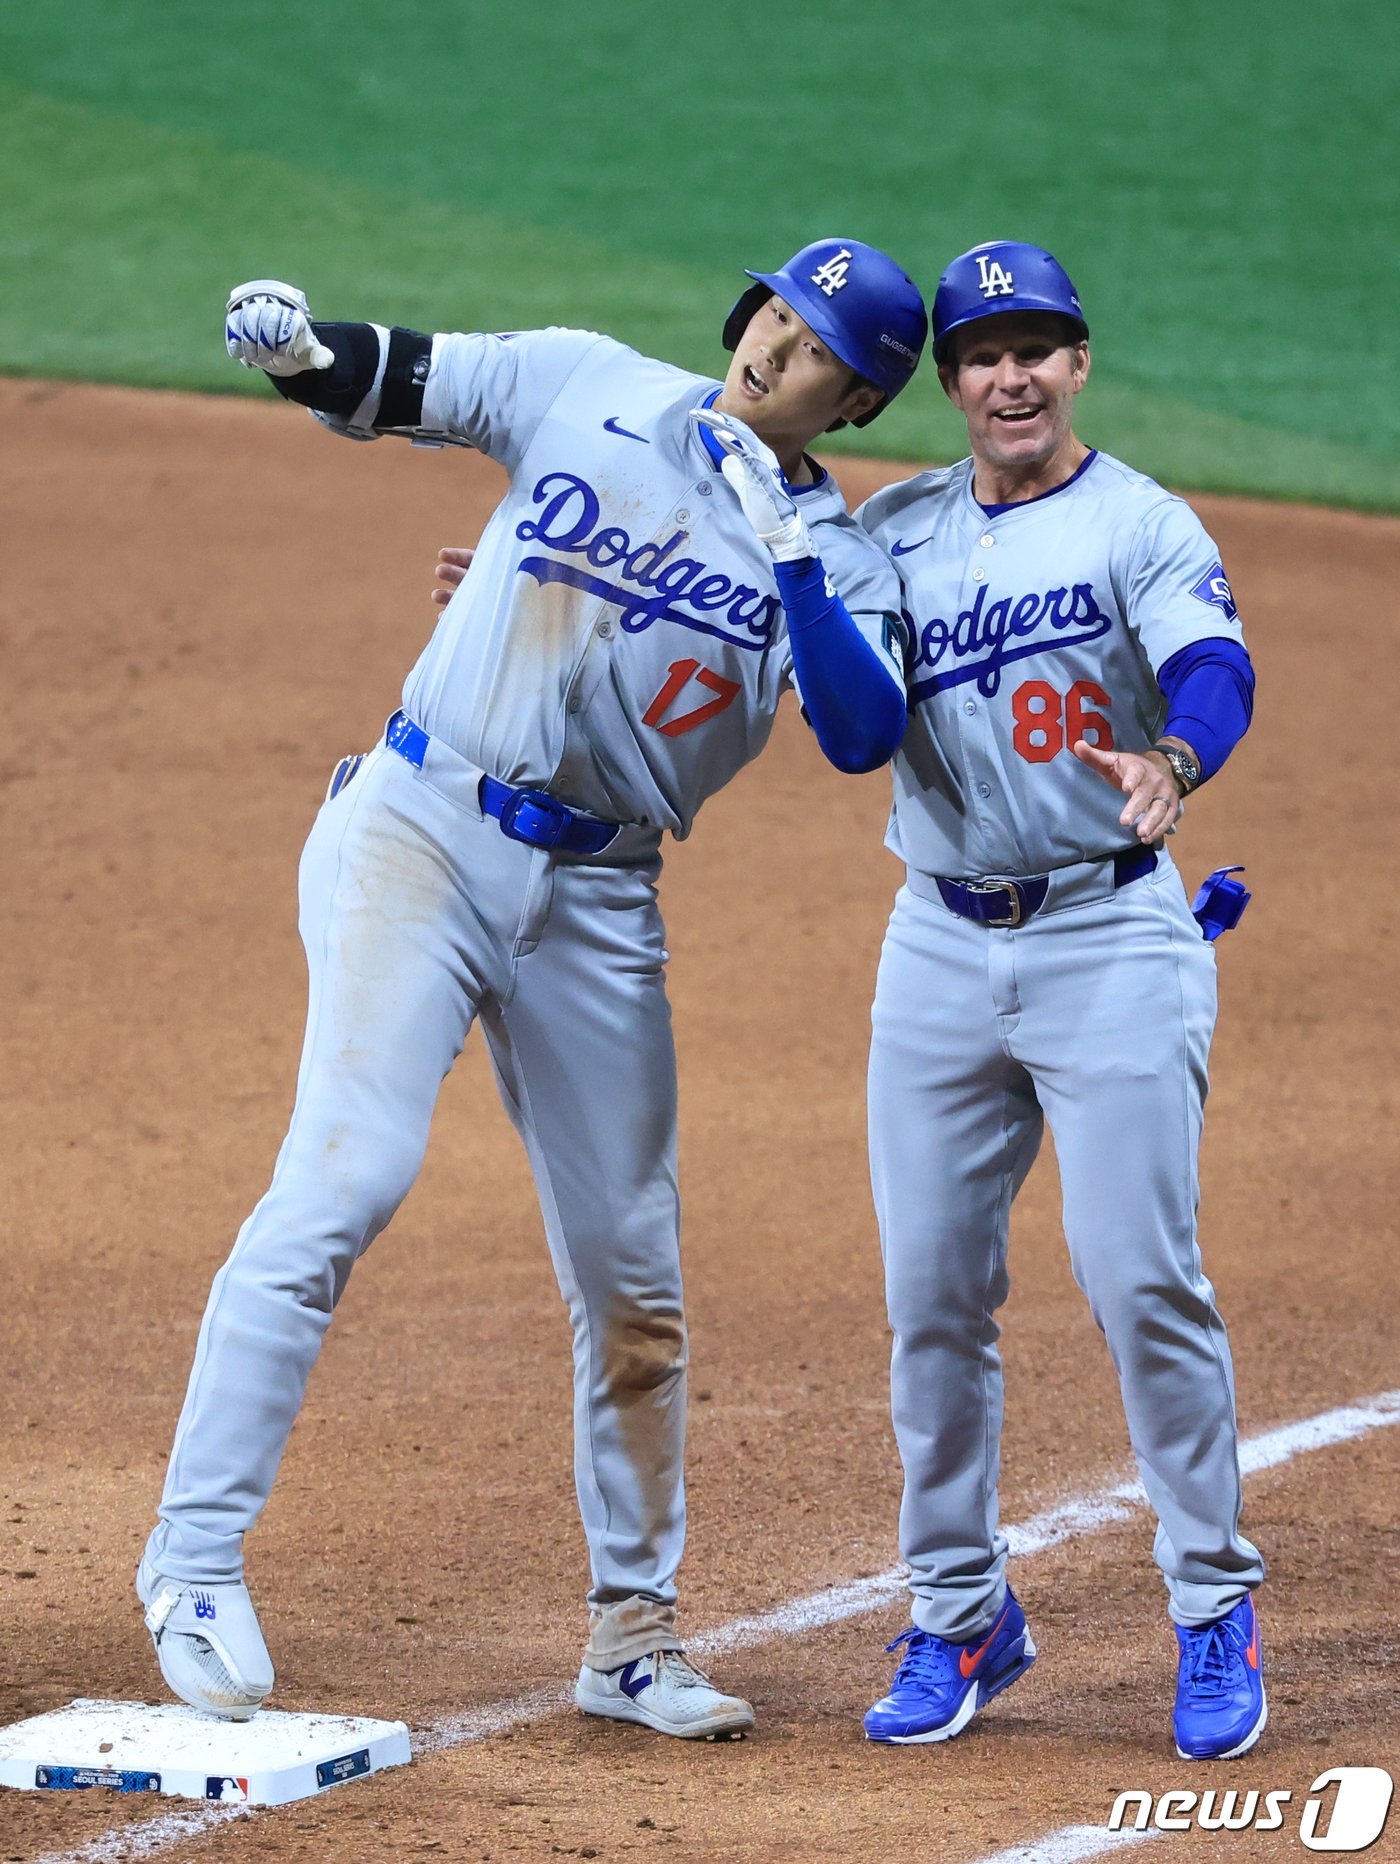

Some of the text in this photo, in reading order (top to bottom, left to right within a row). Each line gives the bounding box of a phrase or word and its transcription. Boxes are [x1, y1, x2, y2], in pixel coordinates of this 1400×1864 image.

[810, 249, 853, 297] LA
[975, 255, 1014, 298] LA
[515, 472, 783, 636] Dodgers
[641, 658, 742, 738] 17
[1011, 679, 1115, 764] 86
[73, 1775, 124, 1786] SEOUL SERIES
